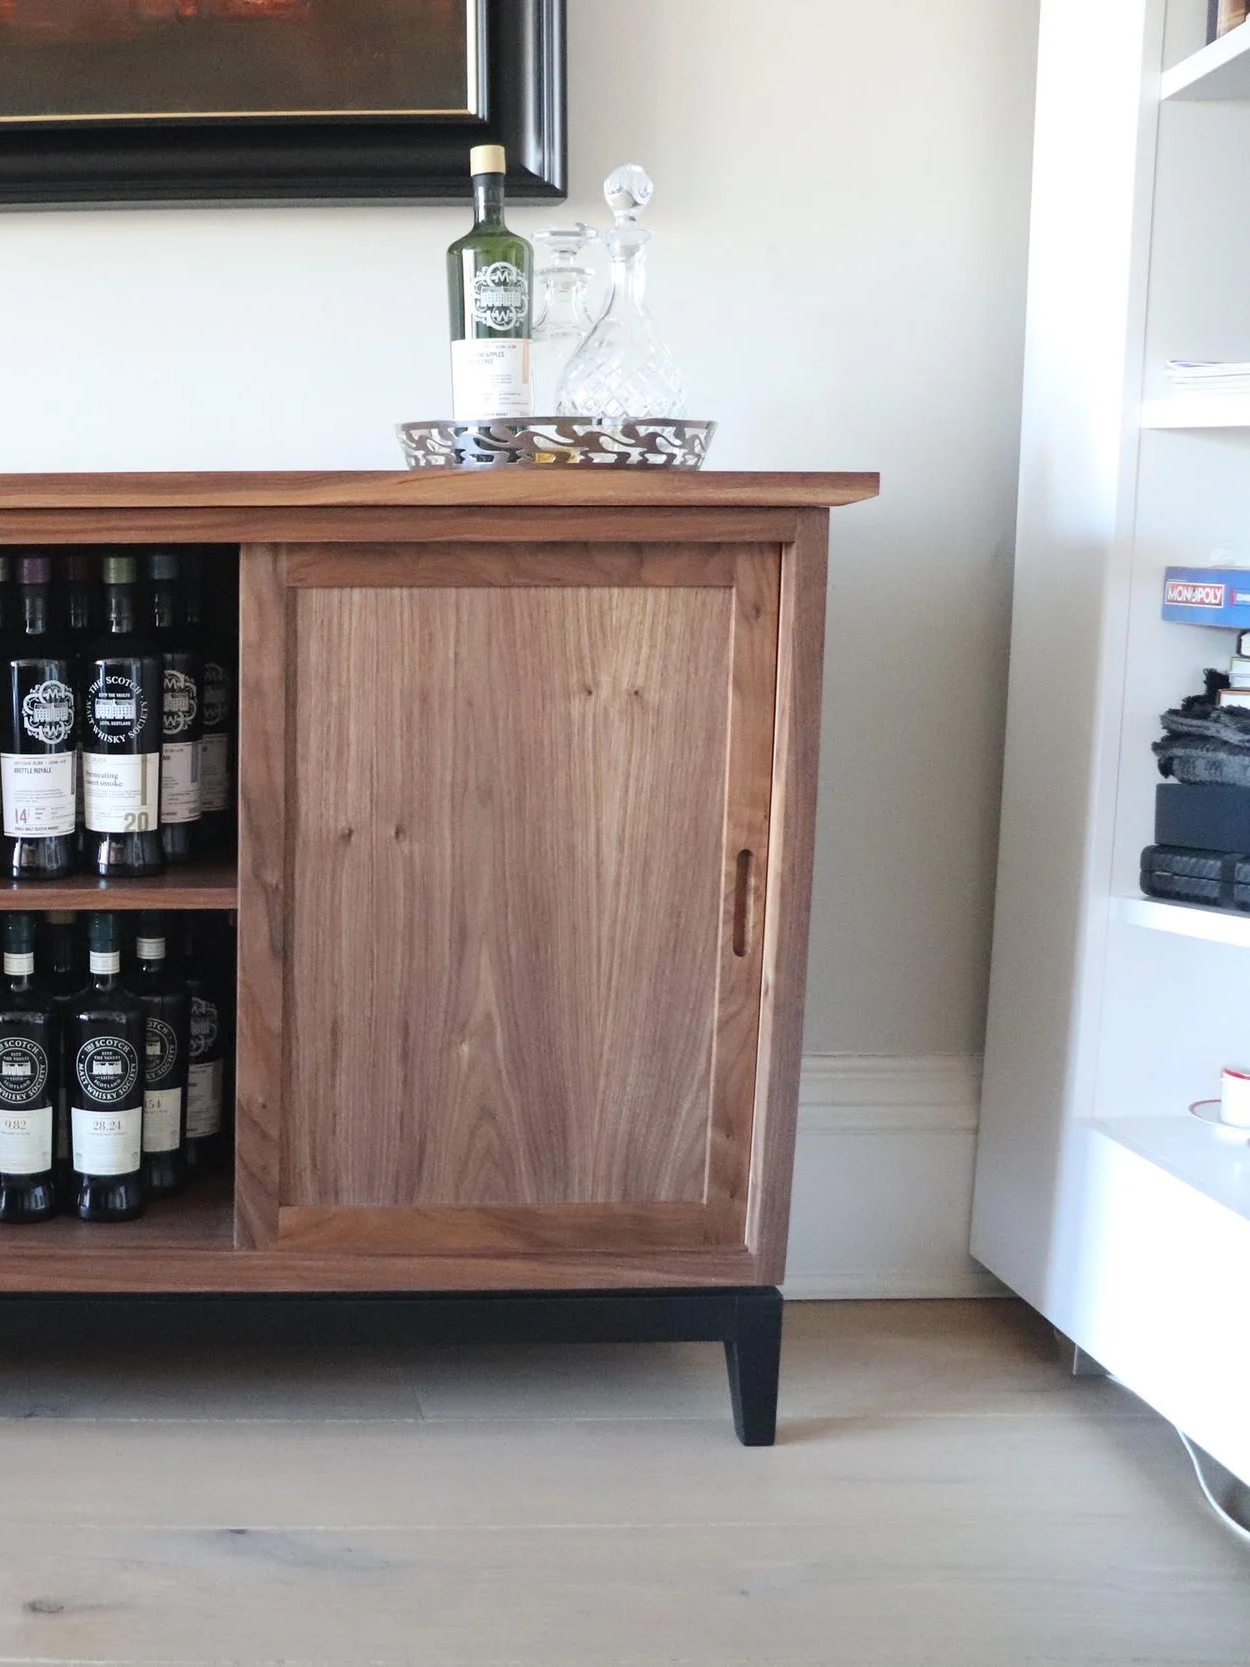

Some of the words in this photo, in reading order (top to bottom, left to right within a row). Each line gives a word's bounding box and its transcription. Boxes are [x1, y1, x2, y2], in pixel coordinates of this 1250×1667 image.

[1167, 585, 1222, 604] MONOPOLY
[89, 678, 103, 694] THE
[105, 675, 142, 695] SCOTCH
[92, 725, 126, 744] WHISKY
[128, 701, 148, 739] SOCIETY
[15, 808, 27, 824] 14
[124, 812, 149, 832] 20
[4, 1039, 39, 1054] SCOTCH
[84, 1043, 95, 1053] THE
[95, 1039, 130, 1053] SCOTCH
[3, 1080, 31, 1089] SCOTLAND
[28, 1064, 46, 1097] SOCIETY
[78, 1063, 88, 1085] MALT
[87, 1084, 118, 1100] WHISKY
[118, 1063, 136, 1095] SOCIETY
[94, 1079, 121, 1089] SCOTLAND
